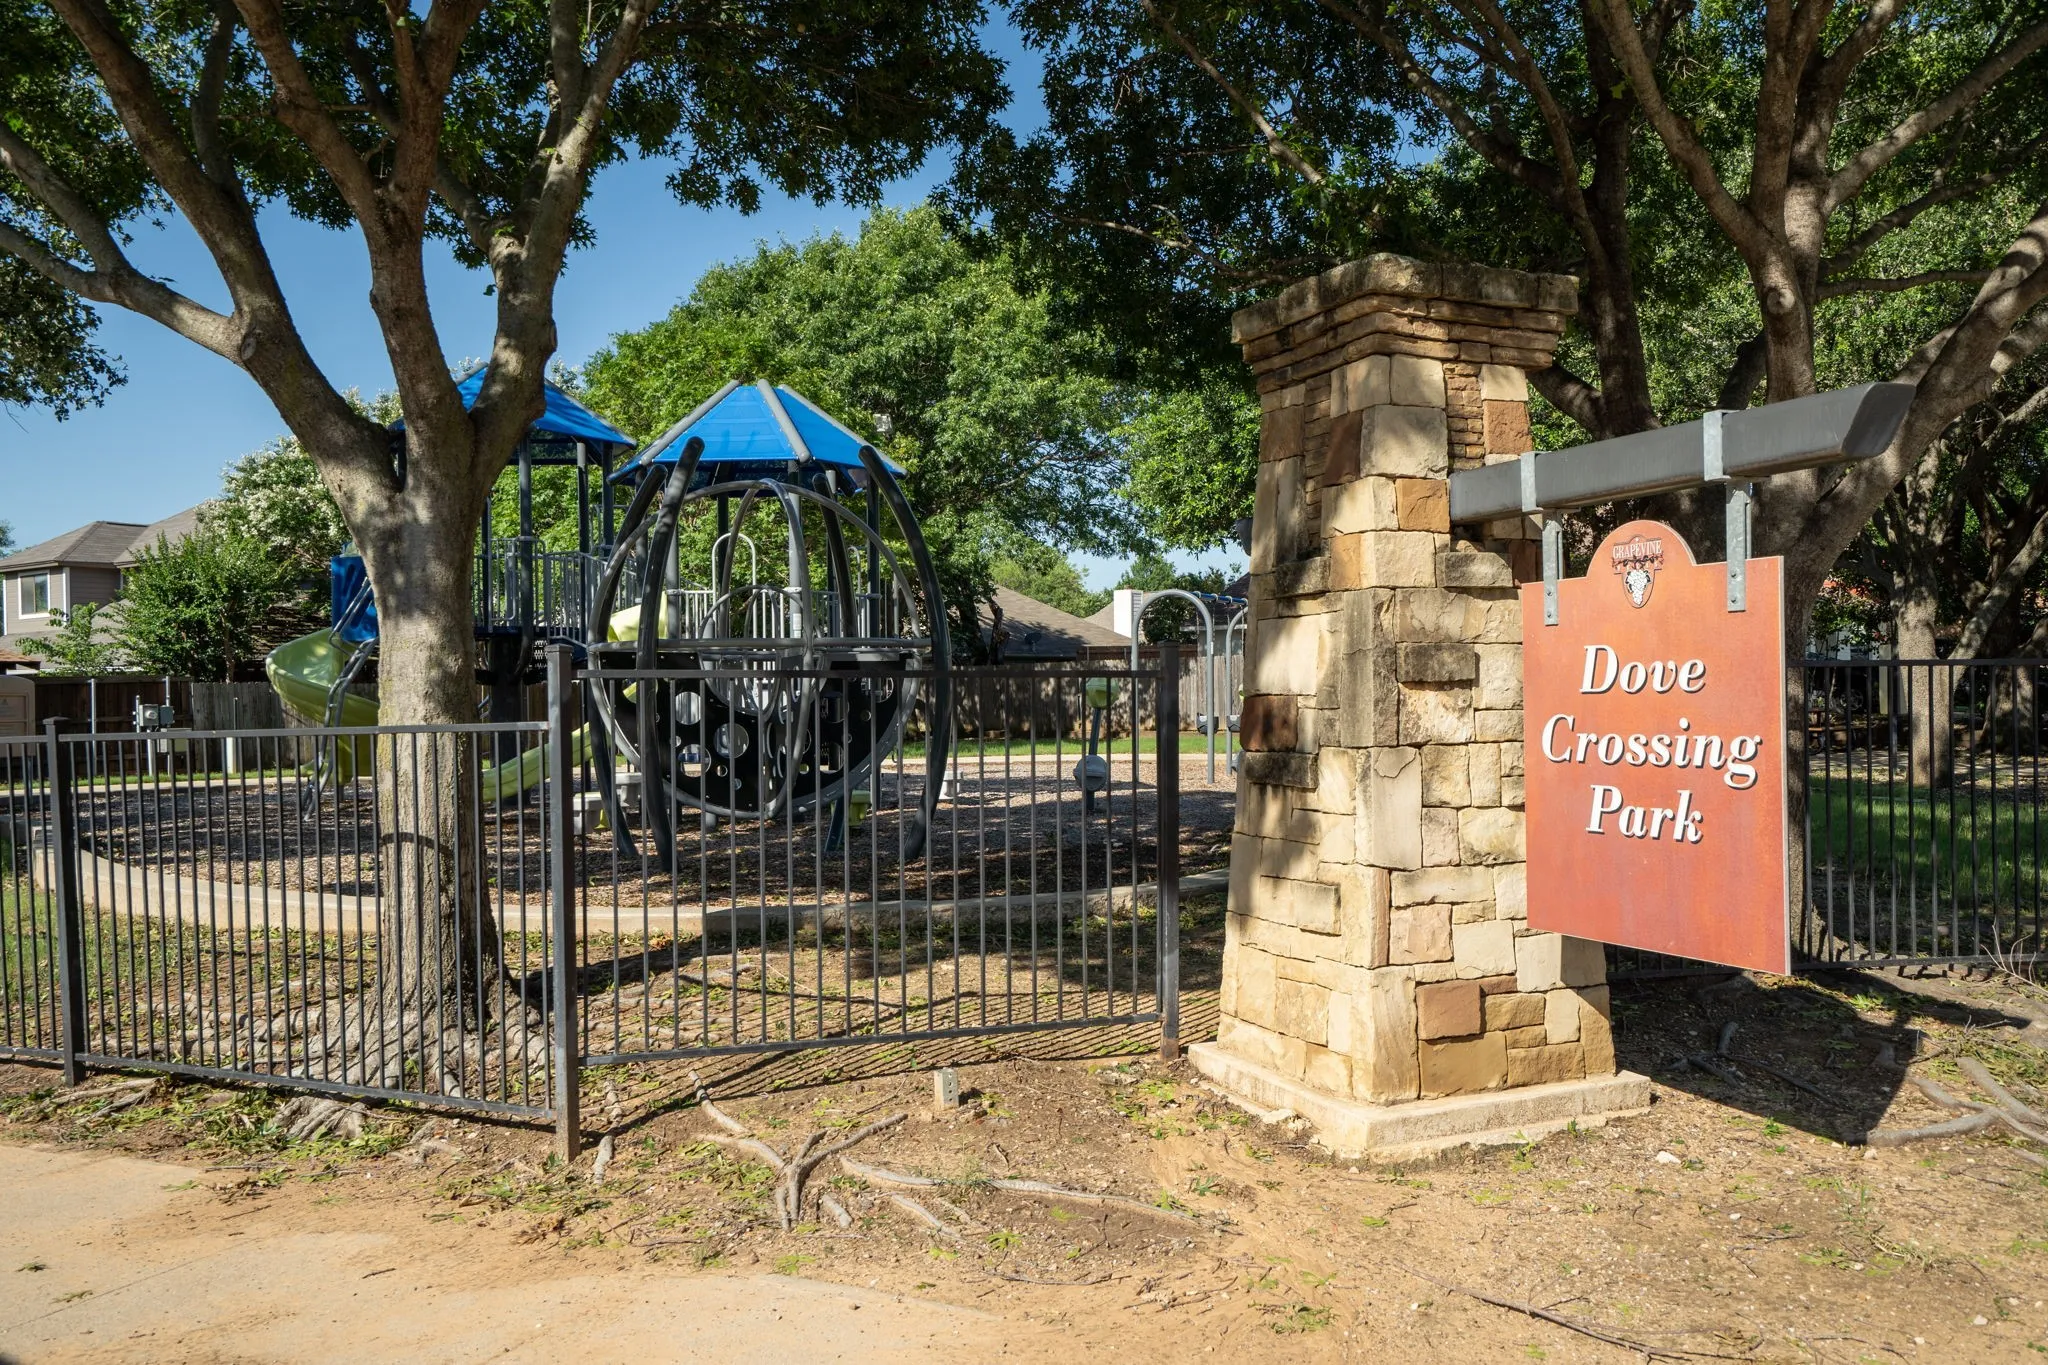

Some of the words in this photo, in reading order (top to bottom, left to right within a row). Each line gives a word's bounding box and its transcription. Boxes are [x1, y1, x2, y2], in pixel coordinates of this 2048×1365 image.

[1612, 540, 1662, 559] GRAPEVINE
[1579, 644, 1706, 694] Dove
[1541, 713, 1763, 789] Crossing
[1585, 784, 1703, 843] Park
